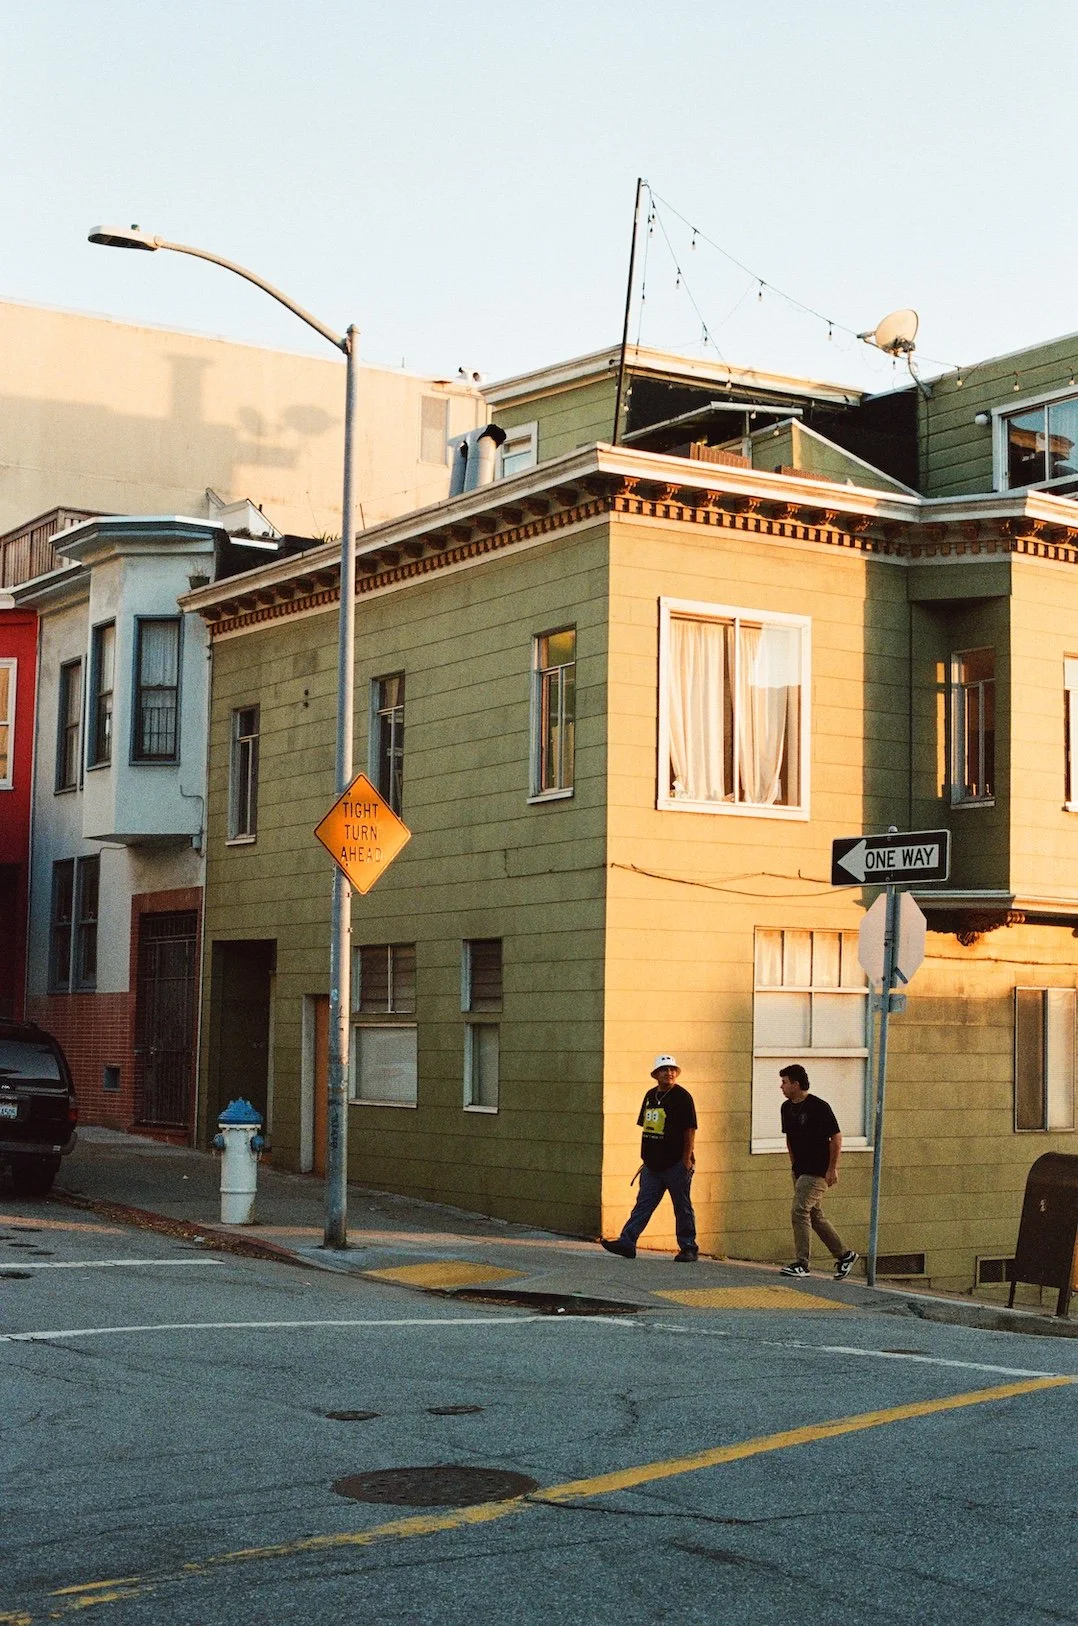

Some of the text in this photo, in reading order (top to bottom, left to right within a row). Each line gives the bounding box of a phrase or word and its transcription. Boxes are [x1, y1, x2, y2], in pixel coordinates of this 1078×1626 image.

[342, 802, 379, 819] TIGHT
[344, 824, 378, 841] TURN
[341, 846, 382, 863] AHEAD
[865, 846, 935, 870] ONE WAY
